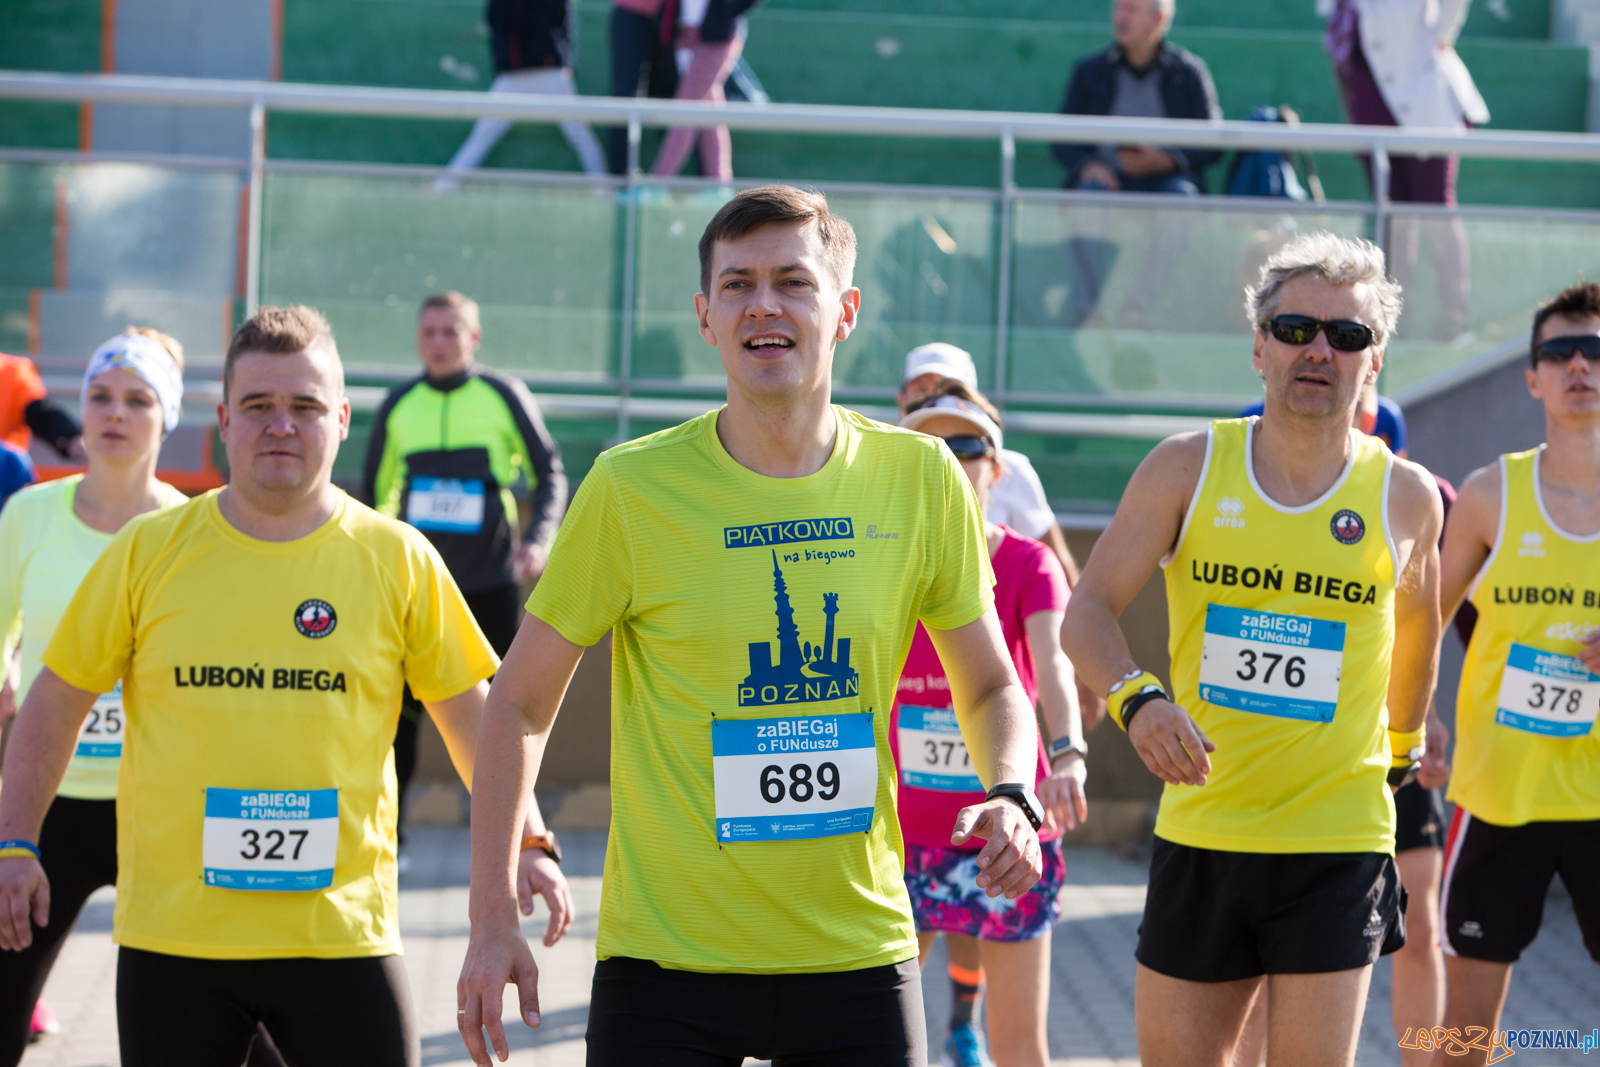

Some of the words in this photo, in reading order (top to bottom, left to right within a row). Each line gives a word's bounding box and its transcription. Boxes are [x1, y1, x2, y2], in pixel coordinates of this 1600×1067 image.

[726, 519, 851, 545] PIĄTKOWO
[784, 552, 799, 563] na
[805, 549, 855, 565] biegowo
[1193, 559, 1283, 591] LUBOŃ
[1294, 571, 1376, 605] BIEGA
[1494, 583, 1574, 605] LUBOŃ
[1240, 629, 1248, 638] o
[1250, 628, 1310, 646] FUNdusze
[1241, 614, 1312, 637] zaBIEGaj
[174, 662, 264, 689] LUBOŃ
[272, 668, 347, 693] BIEGA
[1236, 649, 1306, 688] 376
[740, 676, 858, 704] POZNAŃ
[1527, 682, 1582, 714] 378
[756, 719, 838, 738] zaBIEGaj
[757, 743, 766, 751] o
[770, 738, 839, 751] FUNdusze
[759, 761, 841, 804] 689
[240, 793, 310, 810] zaBIEGaj
[241, 810, 248, 818] o
[251, 808, 310, 818] FUNdusze
[240, 829, 309, 860] 327
